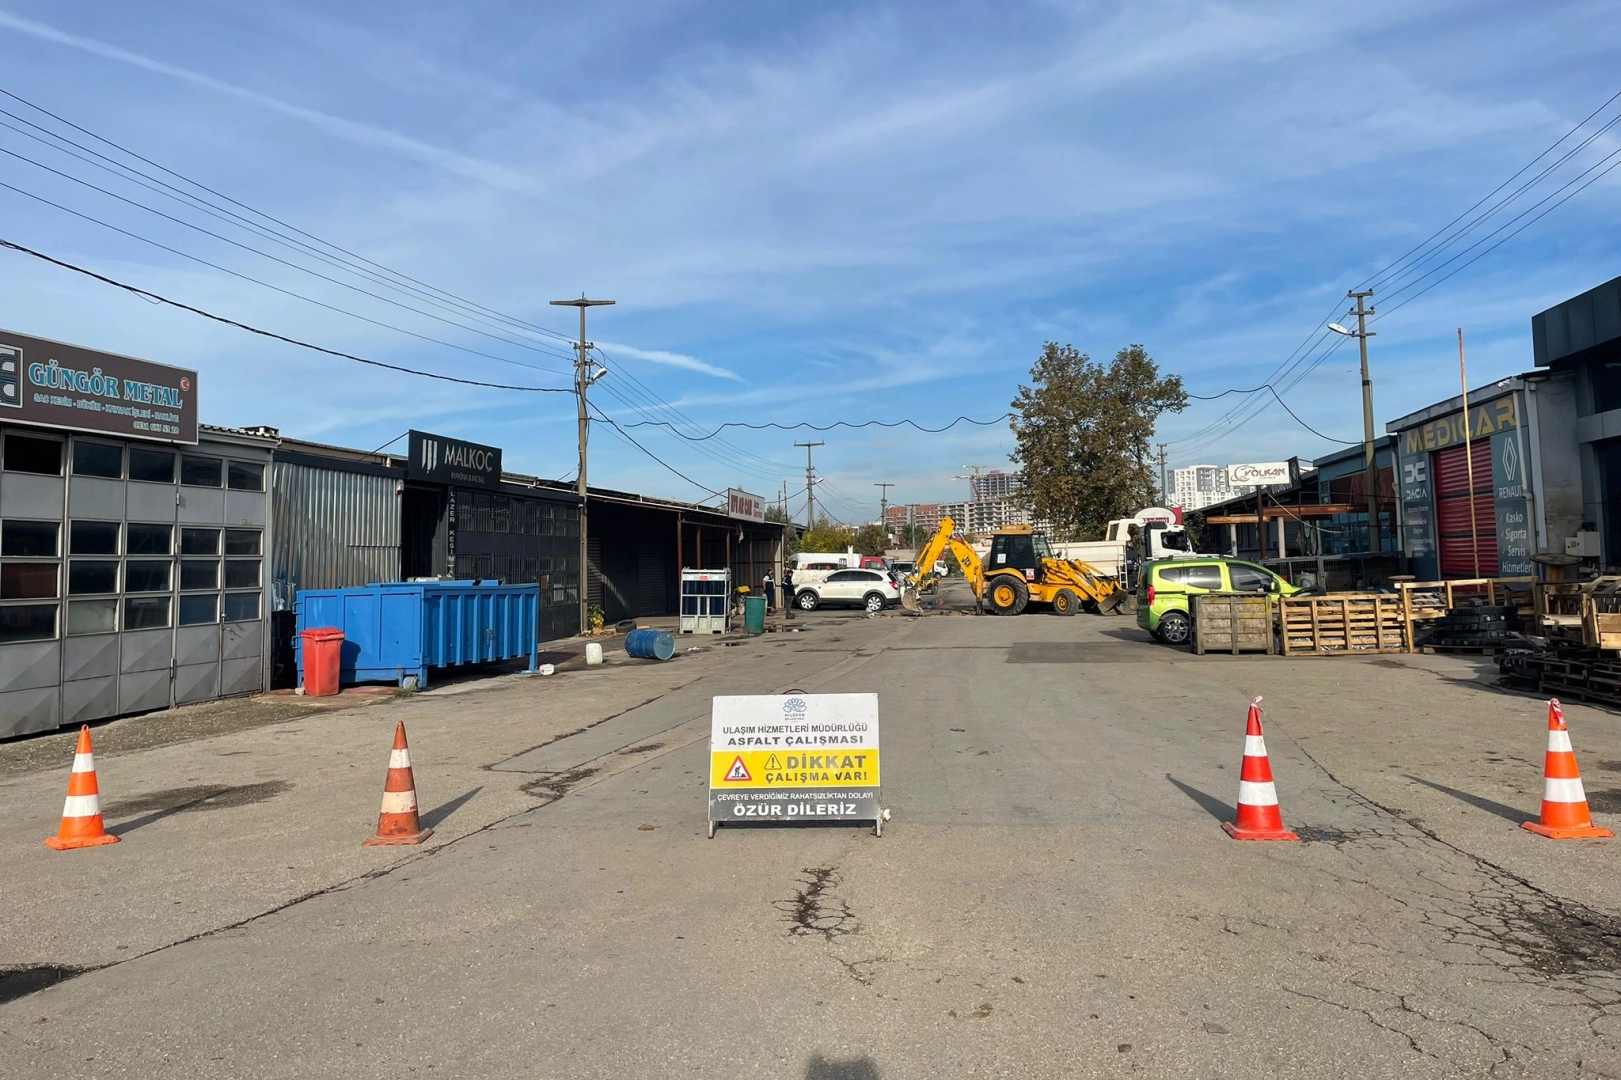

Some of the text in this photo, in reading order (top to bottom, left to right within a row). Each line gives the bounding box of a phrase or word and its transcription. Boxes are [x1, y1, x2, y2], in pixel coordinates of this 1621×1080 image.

[28, 359, 183, 409] GÜNGÖR METAL
[33, 392, 50, 404] SAC
[444, 443, 494, 473] MALKOÇ
[1244, 467, 1286, 478] VOLKAN
[1405, 487, 1428, 500] DACIA
[1498, 485, 1524, 499] RENAUL
[1505, 511, 1523, 523] Kasko
[1505, 527, 1527, 542] Sigorta
[1507, 544, 1526, 557] Servis
[722, 722, 868, 735] ULAŞIM HİZMETLERİ MÜDÜRLÜĞÜ
[728, 735, 864, 747] ASFALT ÇALIŞMASI
[786, 753, 867, 769] DİKKAT
[765, 771, 868, 784] ÇALIŞMA VAR!
[717, 793, 749, 802] ÇEVREYE
[750, 791, 789, 800] VERDİĞİMİZ
[849, 791, 874, 799] DOLAYI
[733, 802, 857, 816] ÖZÜR DİLERİZ
